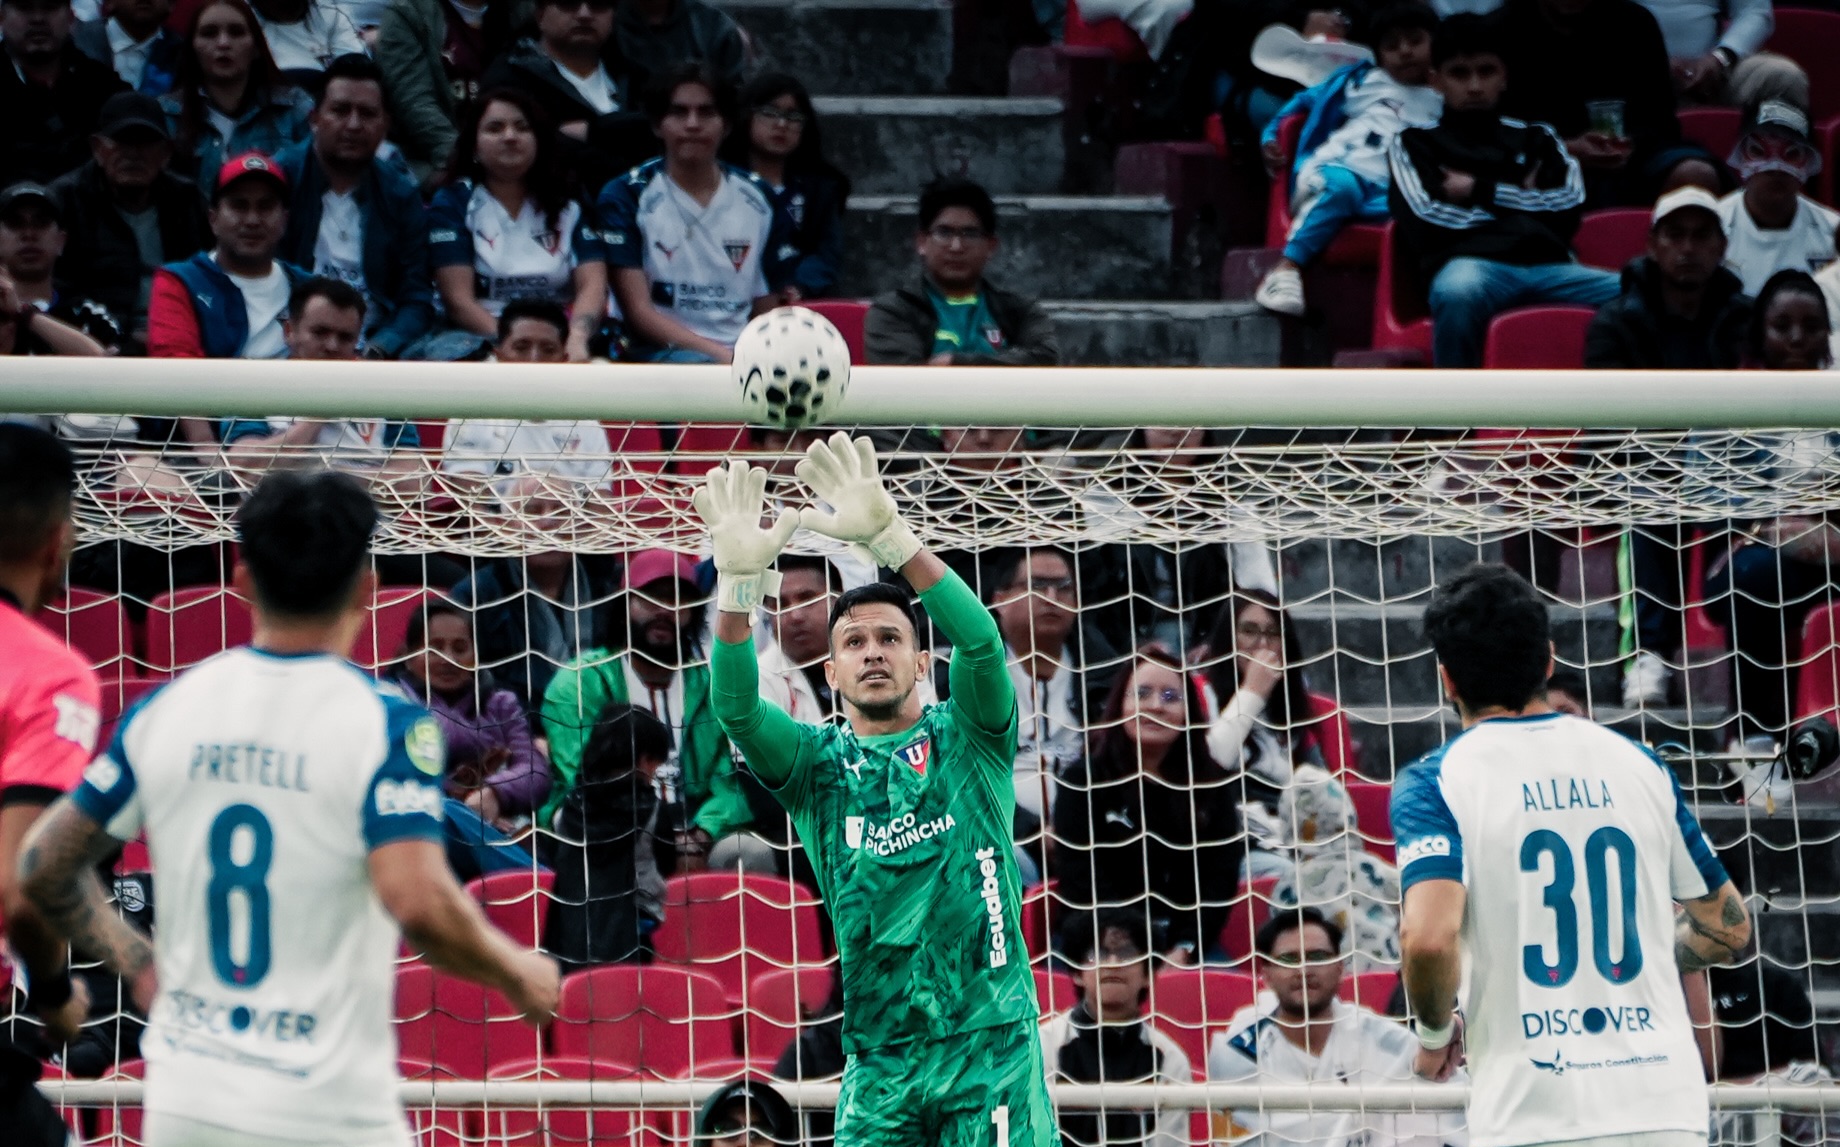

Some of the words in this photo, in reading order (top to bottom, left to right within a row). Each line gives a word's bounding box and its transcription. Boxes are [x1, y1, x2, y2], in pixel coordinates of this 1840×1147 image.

[189, 743, 311, 791] PRETELL
[1522, 778, 1615, 812] ALLALA
[865, 814, 956, 856] PICHINCHA
[208, 802, 274, 990] 8
[975, 847, 1007, 969] Ecuabet
[1519, 826, 1643, 988] 30
[1522, 1006, 1655, 1040] DISCOVER
